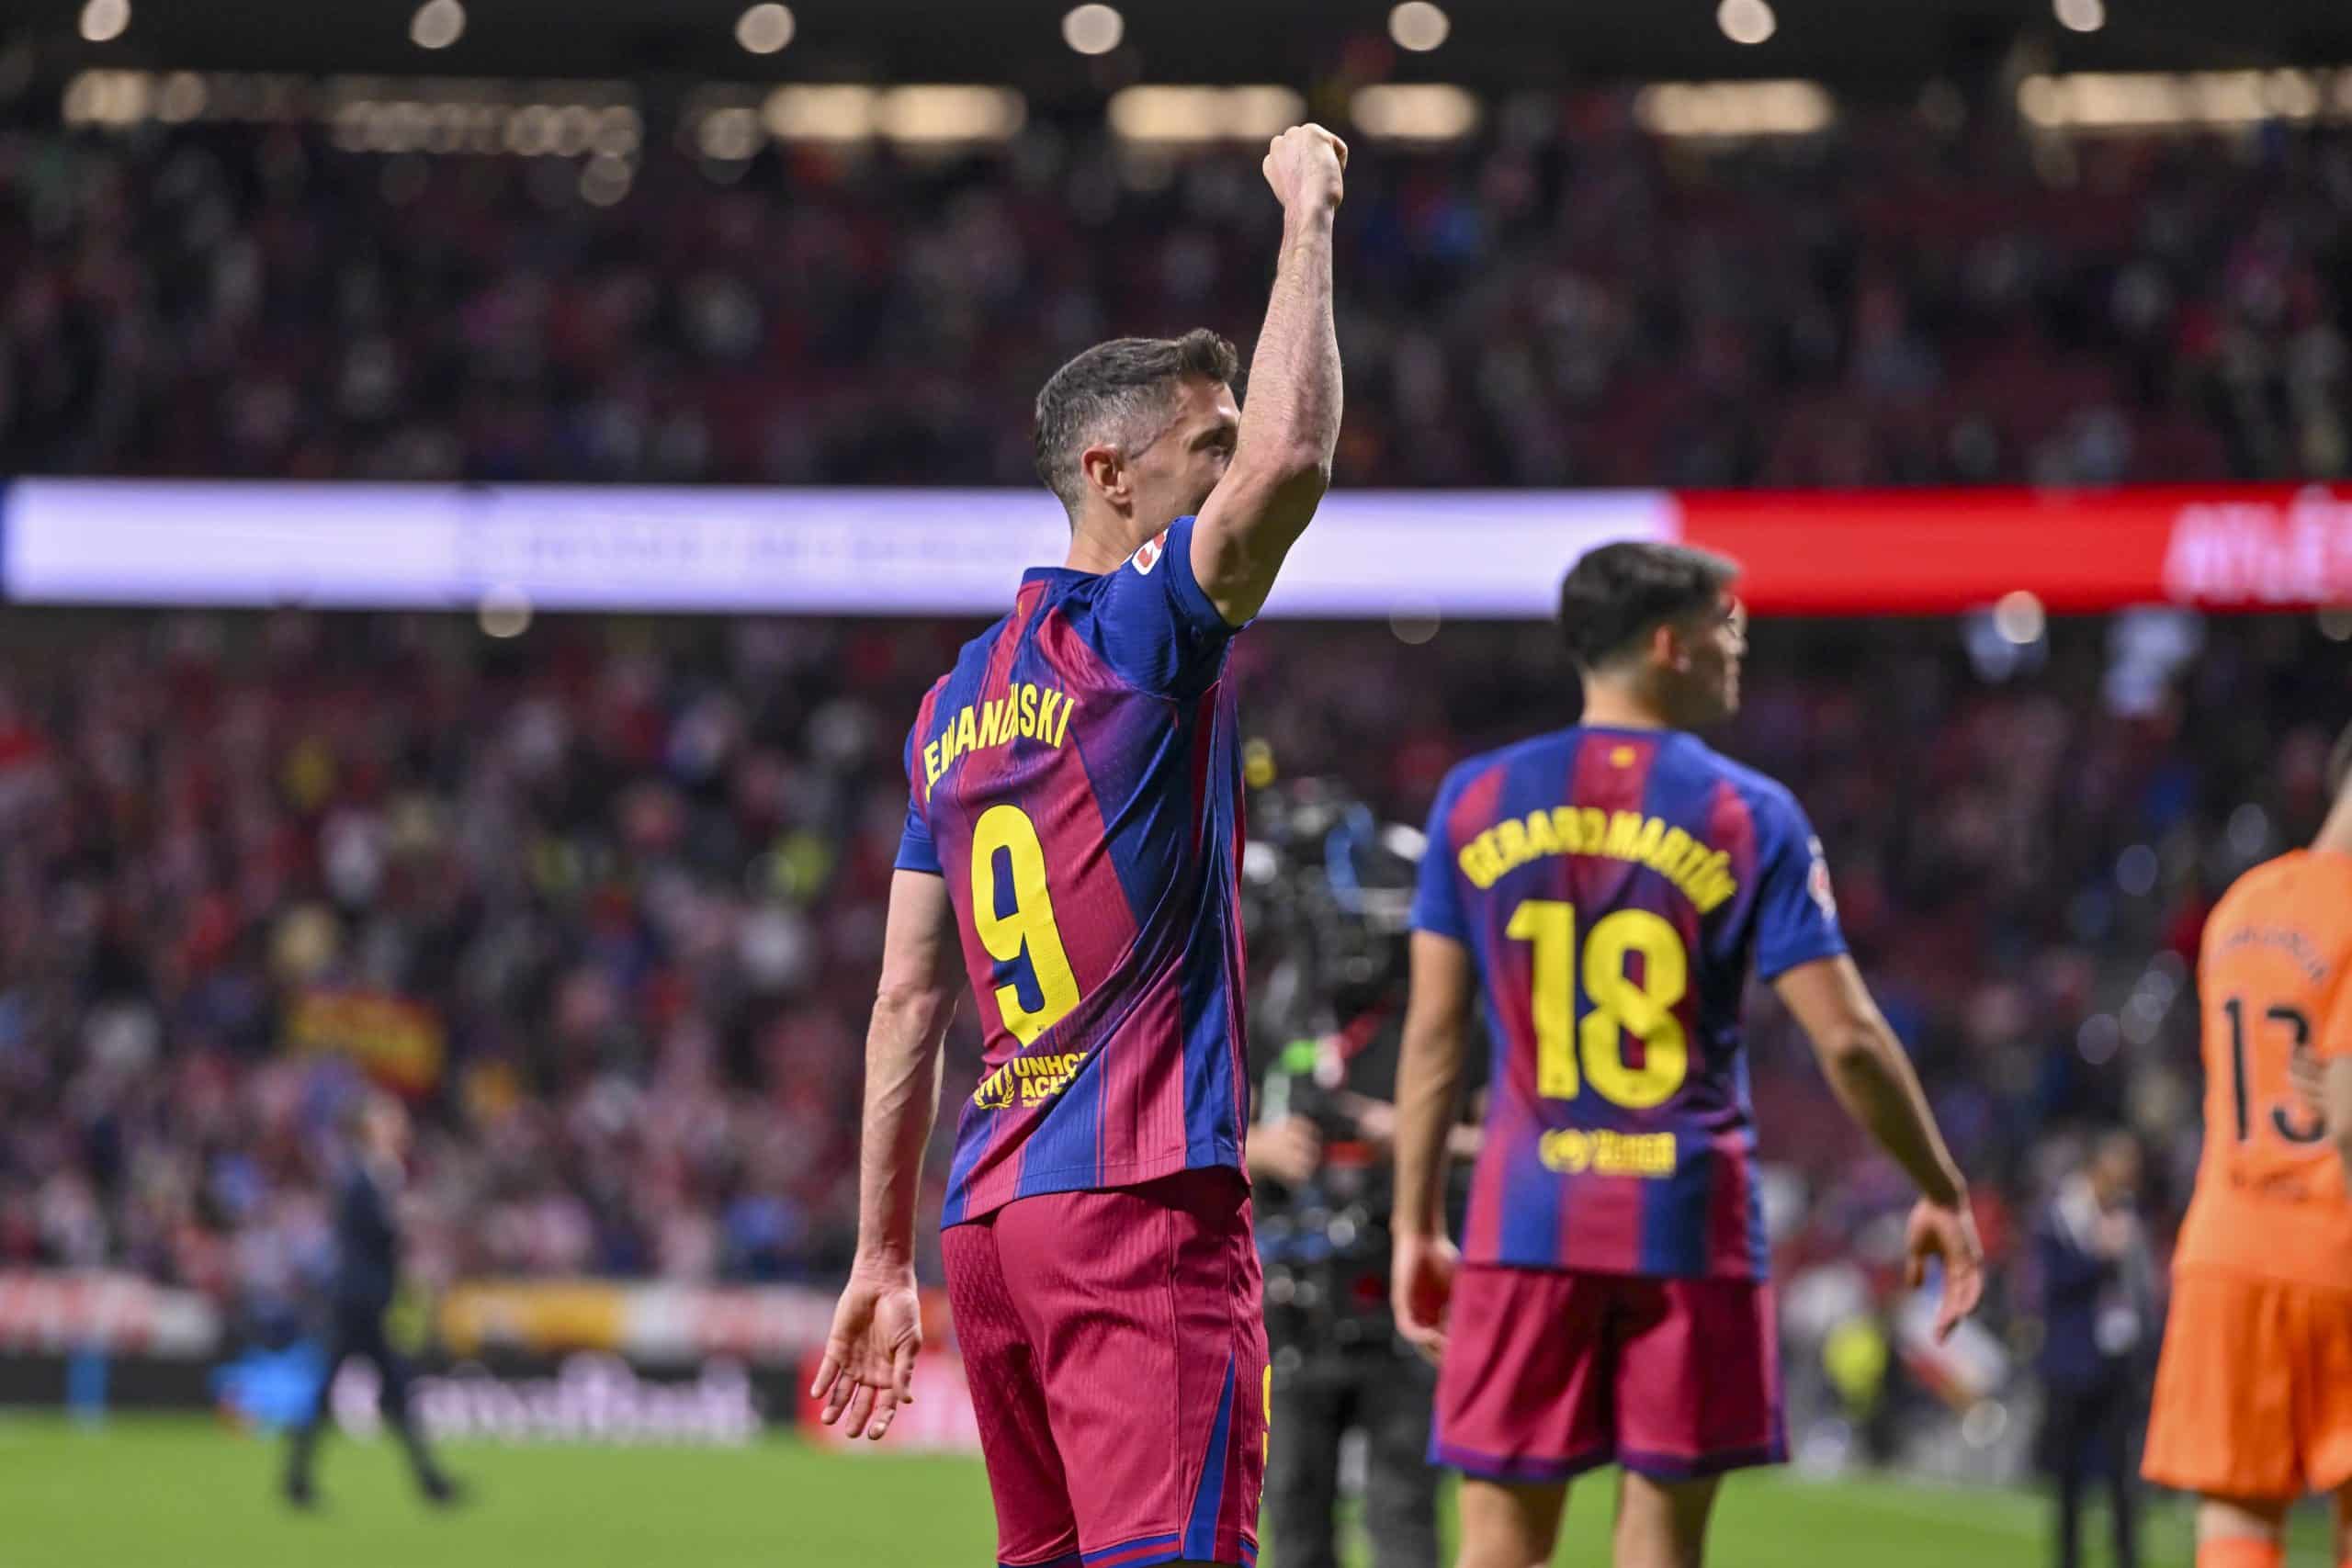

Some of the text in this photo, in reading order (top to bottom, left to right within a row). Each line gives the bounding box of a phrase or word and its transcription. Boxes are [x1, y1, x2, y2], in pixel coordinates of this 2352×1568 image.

[971, 804, 1080, 1048] 9
[1505, 899, 1688, 1110] 18
[2224, 998, 2327, 1144] 13
